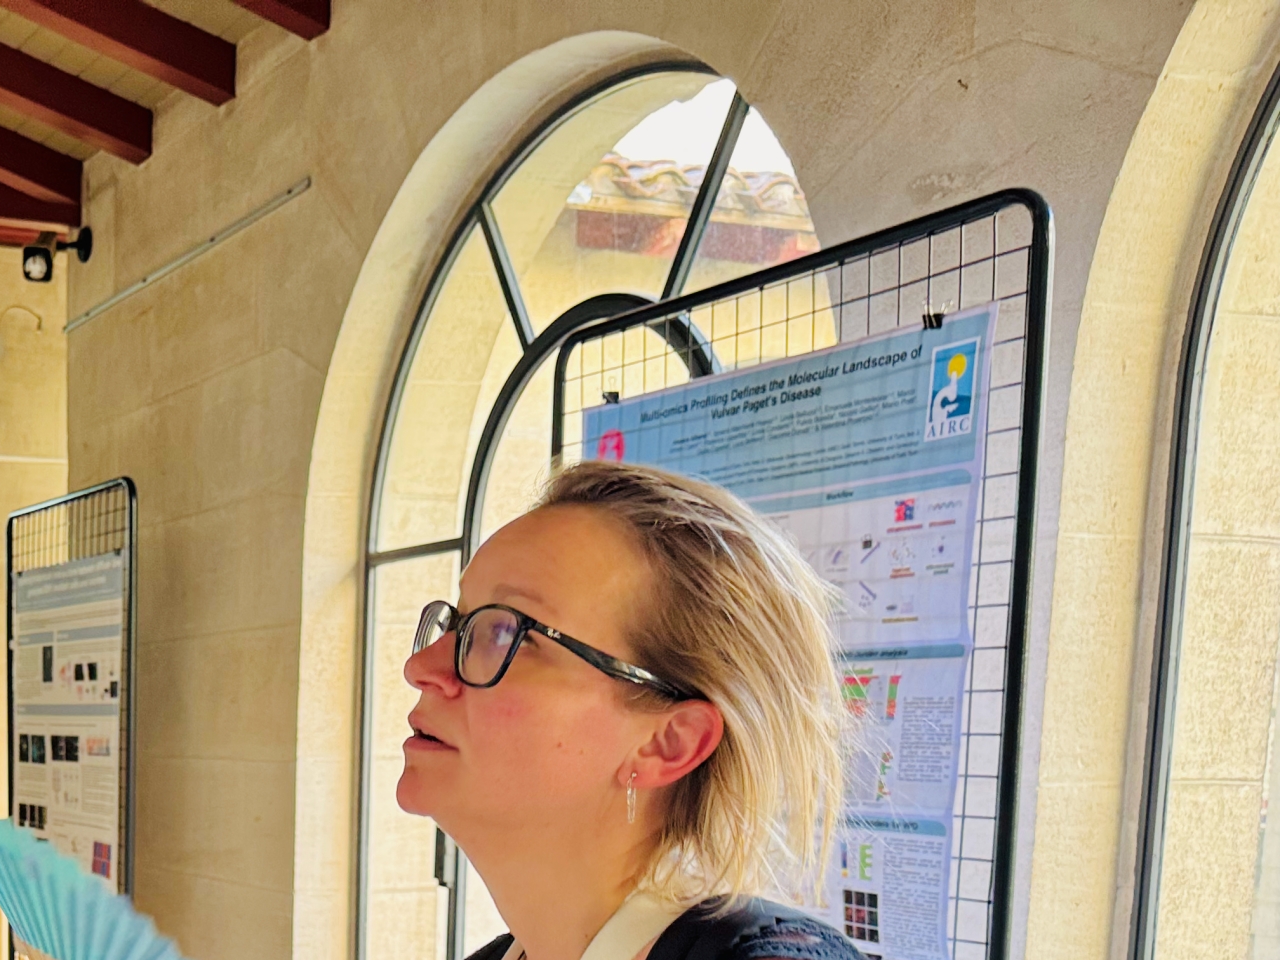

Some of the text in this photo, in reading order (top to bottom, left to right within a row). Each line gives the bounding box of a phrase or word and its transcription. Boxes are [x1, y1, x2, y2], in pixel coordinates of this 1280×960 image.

[690, 390, 728, 412] Profiling
[730, 384, 767, 402] Defines
[768, 378, 785, 393] the
[787, 366, 840, 388] Molecular
[842, 352, 909, 376] Landscape
[910, 344, 923, 360] of
[710, 407, 740, 421] Vulvar
[780, 385, 822, 405] Disease
[926, 416, 970, 439] AIRC
